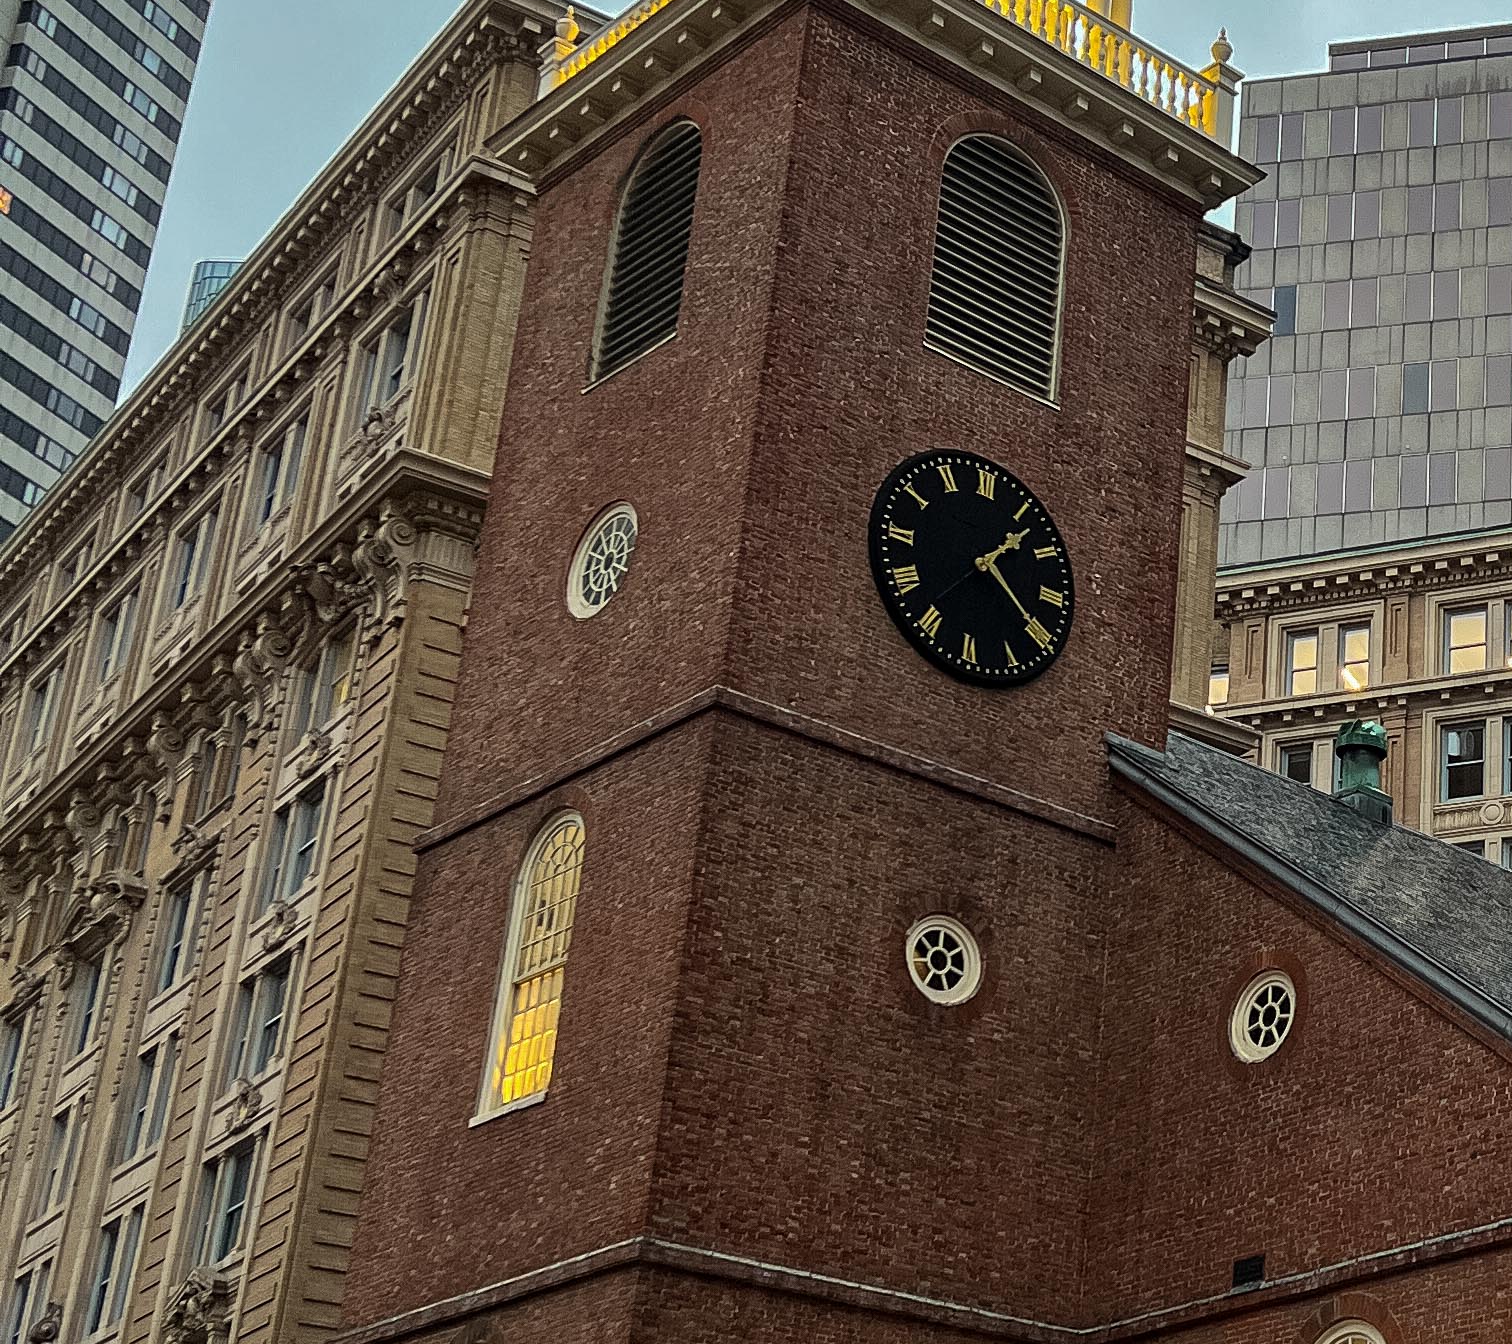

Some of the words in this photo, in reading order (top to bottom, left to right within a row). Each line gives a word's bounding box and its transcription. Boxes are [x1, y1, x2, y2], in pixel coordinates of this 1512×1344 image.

[976, 469, 996, 500] XII
[1013, 501, 1030, 522] I
[1033, 545, 1058, 560] II
[892, 563, 921, 596] VIII
[1038, 584, 1063, 609] III
[917, 604, 943, 639] VII
[961, 633, 978, 664] VI
